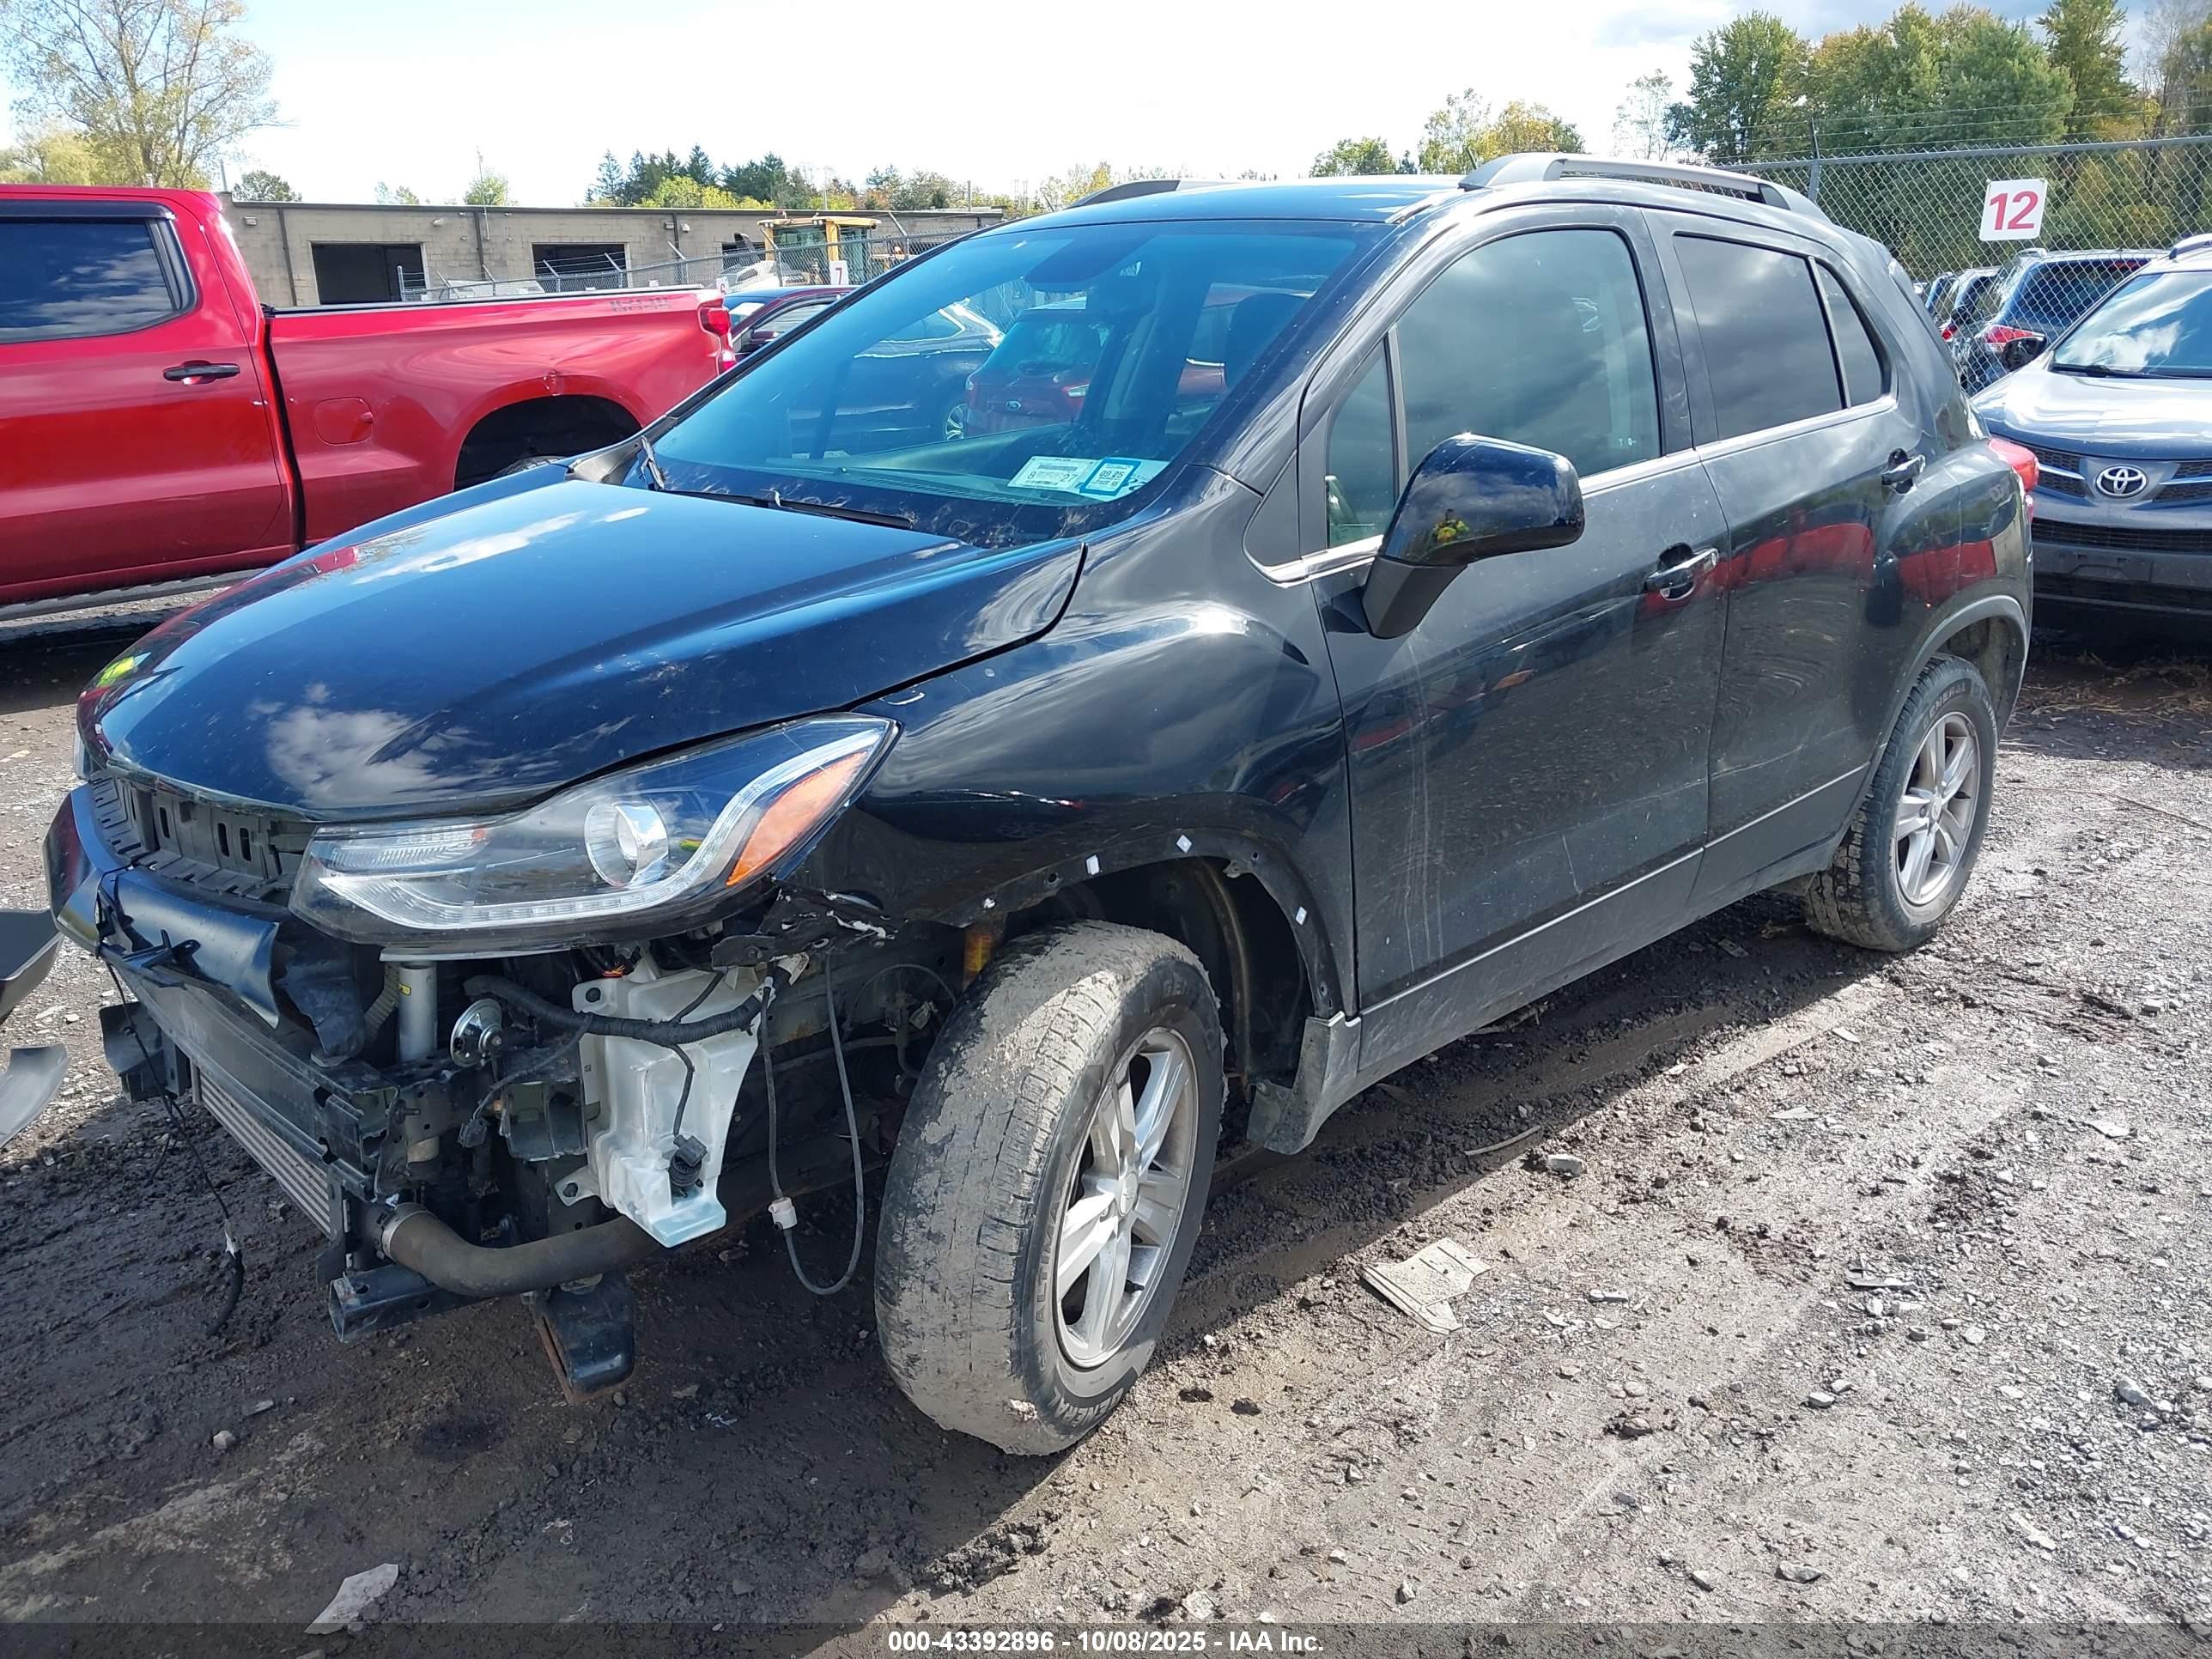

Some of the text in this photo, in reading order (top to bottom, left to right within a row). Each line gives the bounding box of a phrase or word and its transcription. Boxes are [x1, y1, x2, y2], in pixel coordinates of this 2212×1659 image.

[1989, 191, 2039, 230] 12
[835, 266, 843, 285] 7
[1060, 473, 1079, 483] 27
[1048, 1385, 1124, 1428] GENERAL
